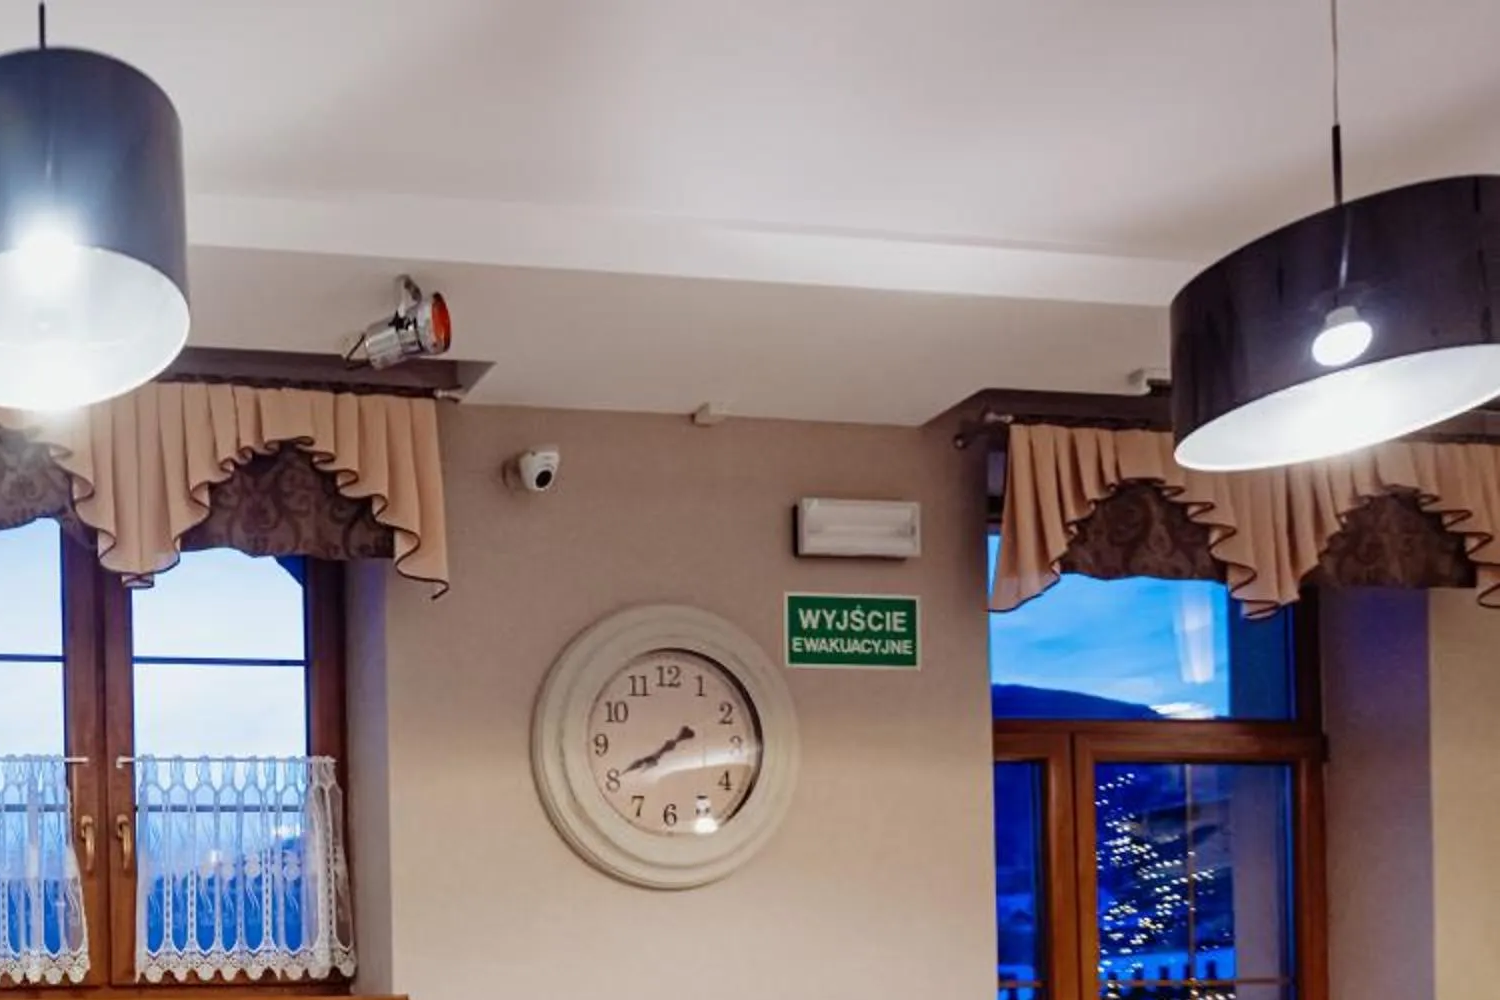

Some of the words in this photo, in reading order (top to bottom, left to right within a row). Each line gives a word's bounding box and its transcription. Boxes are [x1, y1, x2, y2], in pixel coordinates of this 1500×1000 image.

[798, 604, 907, 632] WYJŚCIE
[792, 637, 913, 655] EWAKUACYJNE
[628, 675, 651, 697] 11
[656, 665, 682, 688] 12
[694, 675, 706, 697] 1
[605, 701, 630, 723] 10
[718, 702, 734, 725] 2
[593, 733, 609, 756] 9
[605, 768, 621, 792] 8
[717, 770, 732, 791] 4
[631, 795, 645, 817] 7
[663, 803, 678, 826] 6
